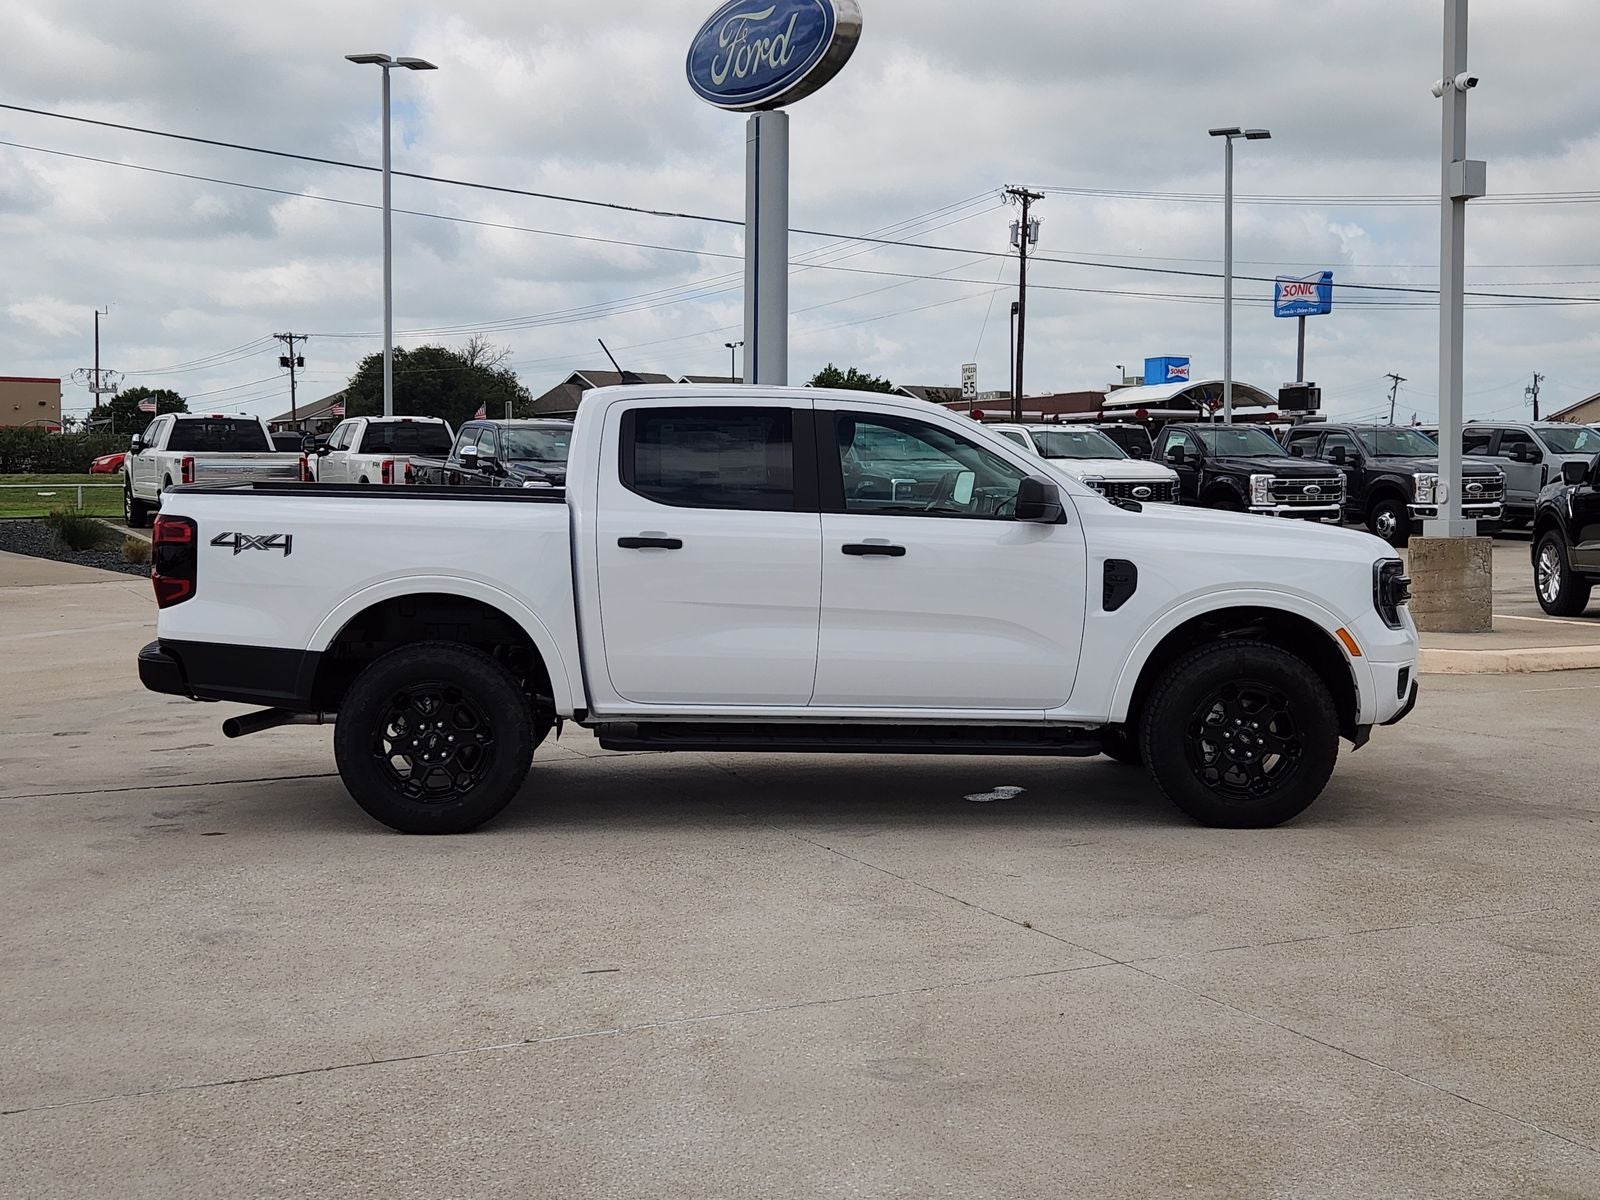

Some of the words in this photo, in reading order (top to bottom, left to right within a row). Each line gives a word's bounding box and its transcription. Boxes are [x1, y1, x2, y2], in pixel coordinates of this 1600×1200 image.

[711, 5, 799, 85] Ford
[1282, 282, 1314, 297] SONIC
[963, 382, 975, 394] 55
